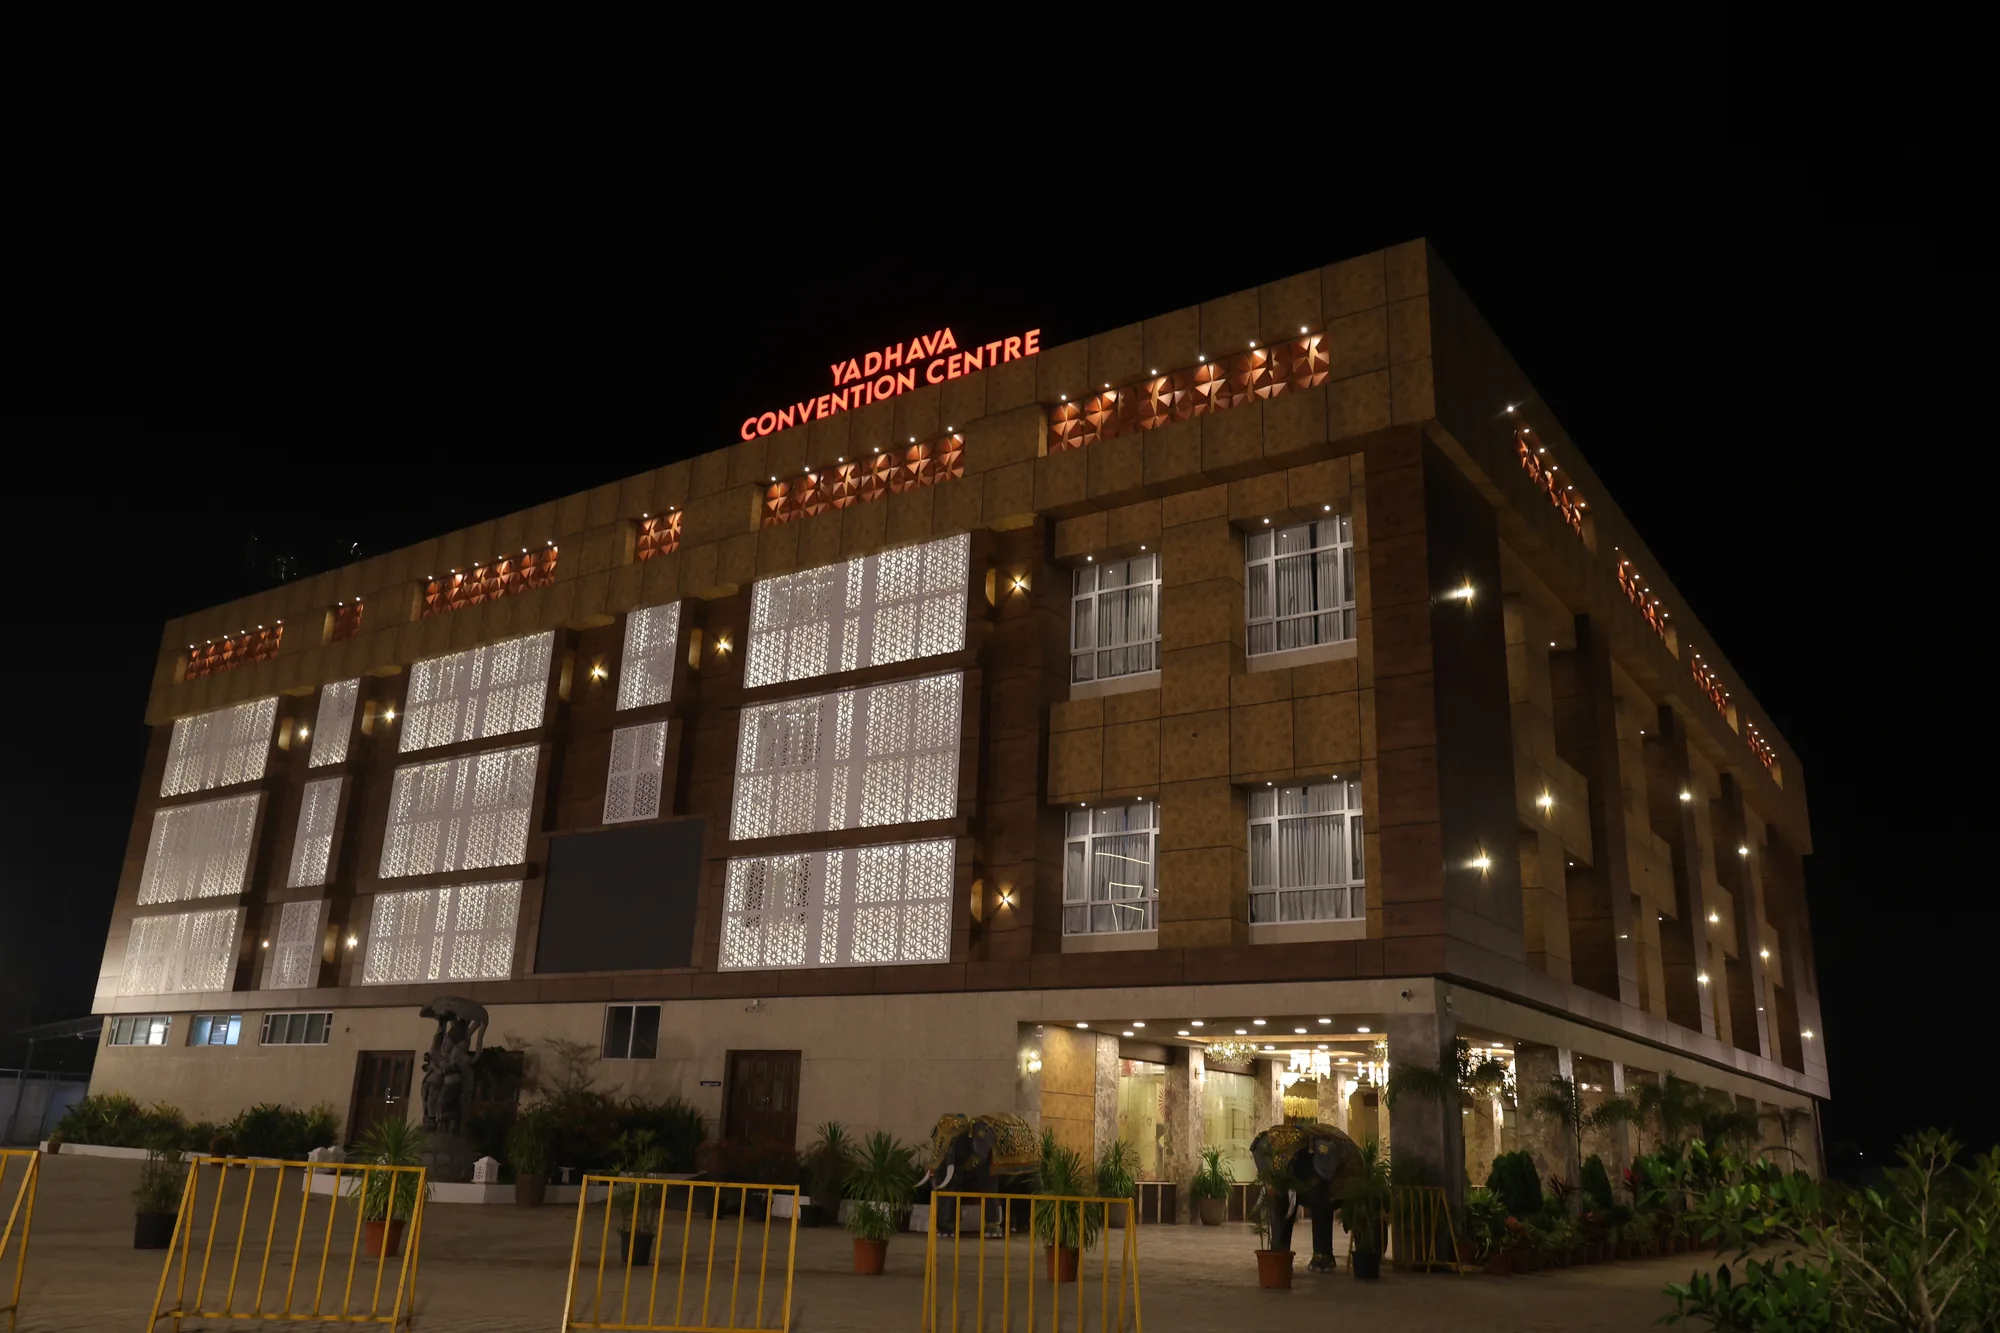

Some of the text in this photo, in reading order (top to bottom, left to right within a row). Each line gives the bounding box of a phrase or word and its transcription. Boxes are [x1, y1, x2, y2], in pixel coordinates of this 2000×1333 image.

[740, 328, 1041, 441] CONVENTION CENTRE
[829, 327, 958, 387] YADHAVA
